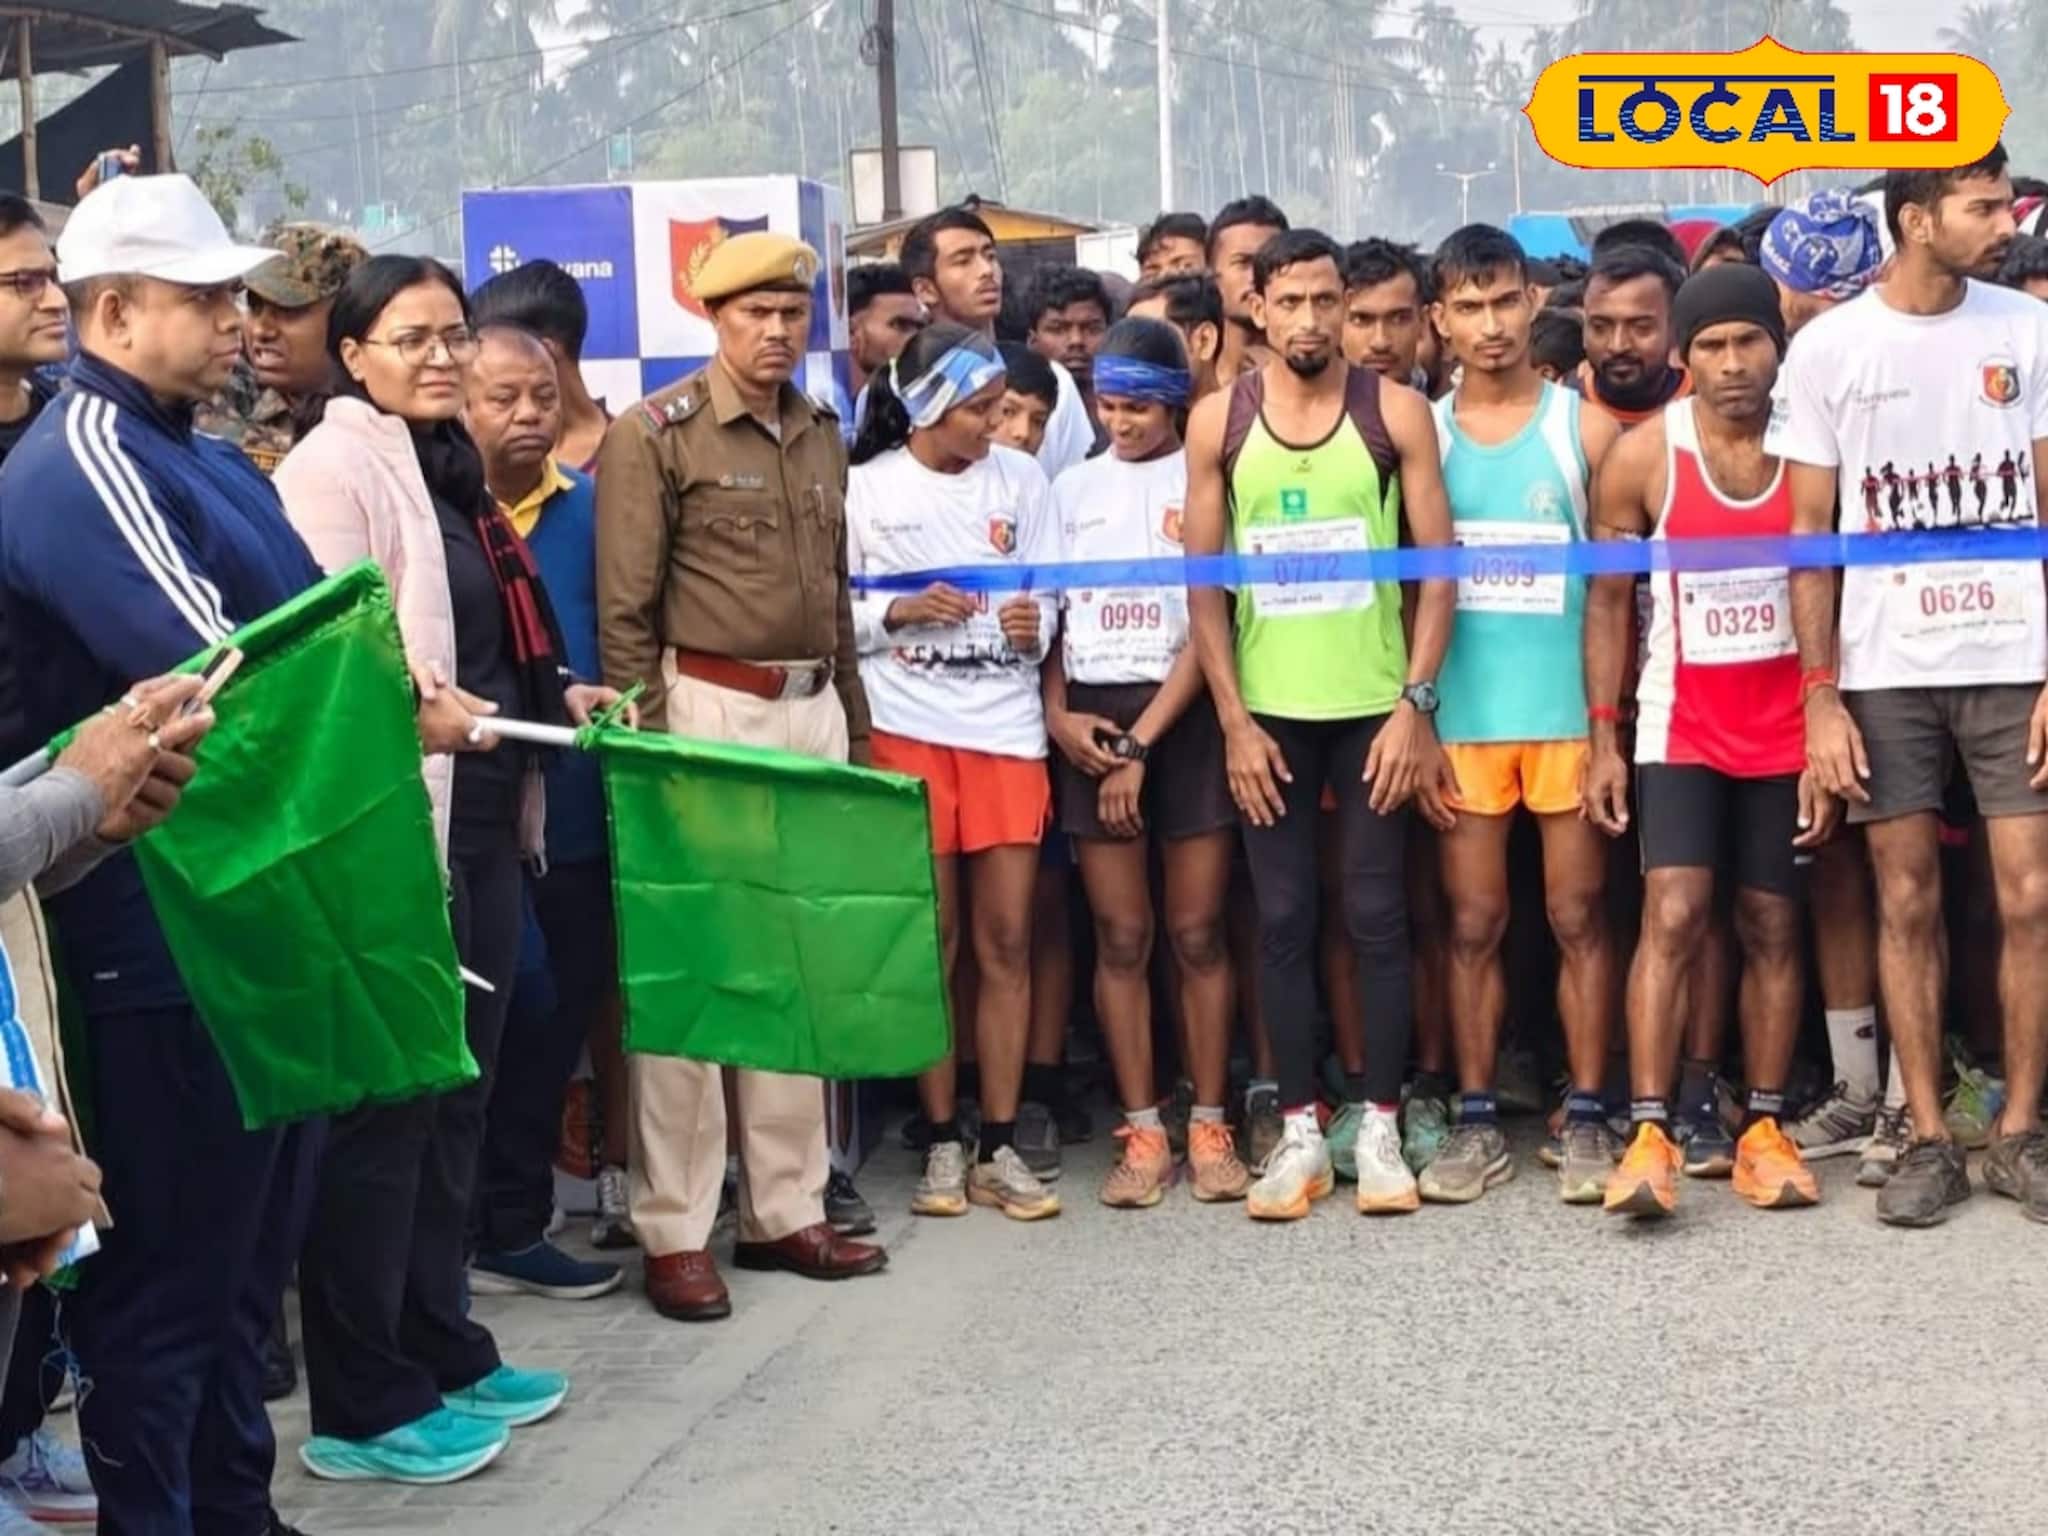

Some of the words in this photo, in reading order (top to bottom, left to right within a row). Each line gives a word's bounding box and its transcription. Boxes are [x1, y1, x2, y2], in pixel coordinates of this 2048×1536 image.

[1101, 602, 1161, 631] 0999
[1920, 581, 1995, 617] 0626
[1705, 603, 1776, 638] 0329
